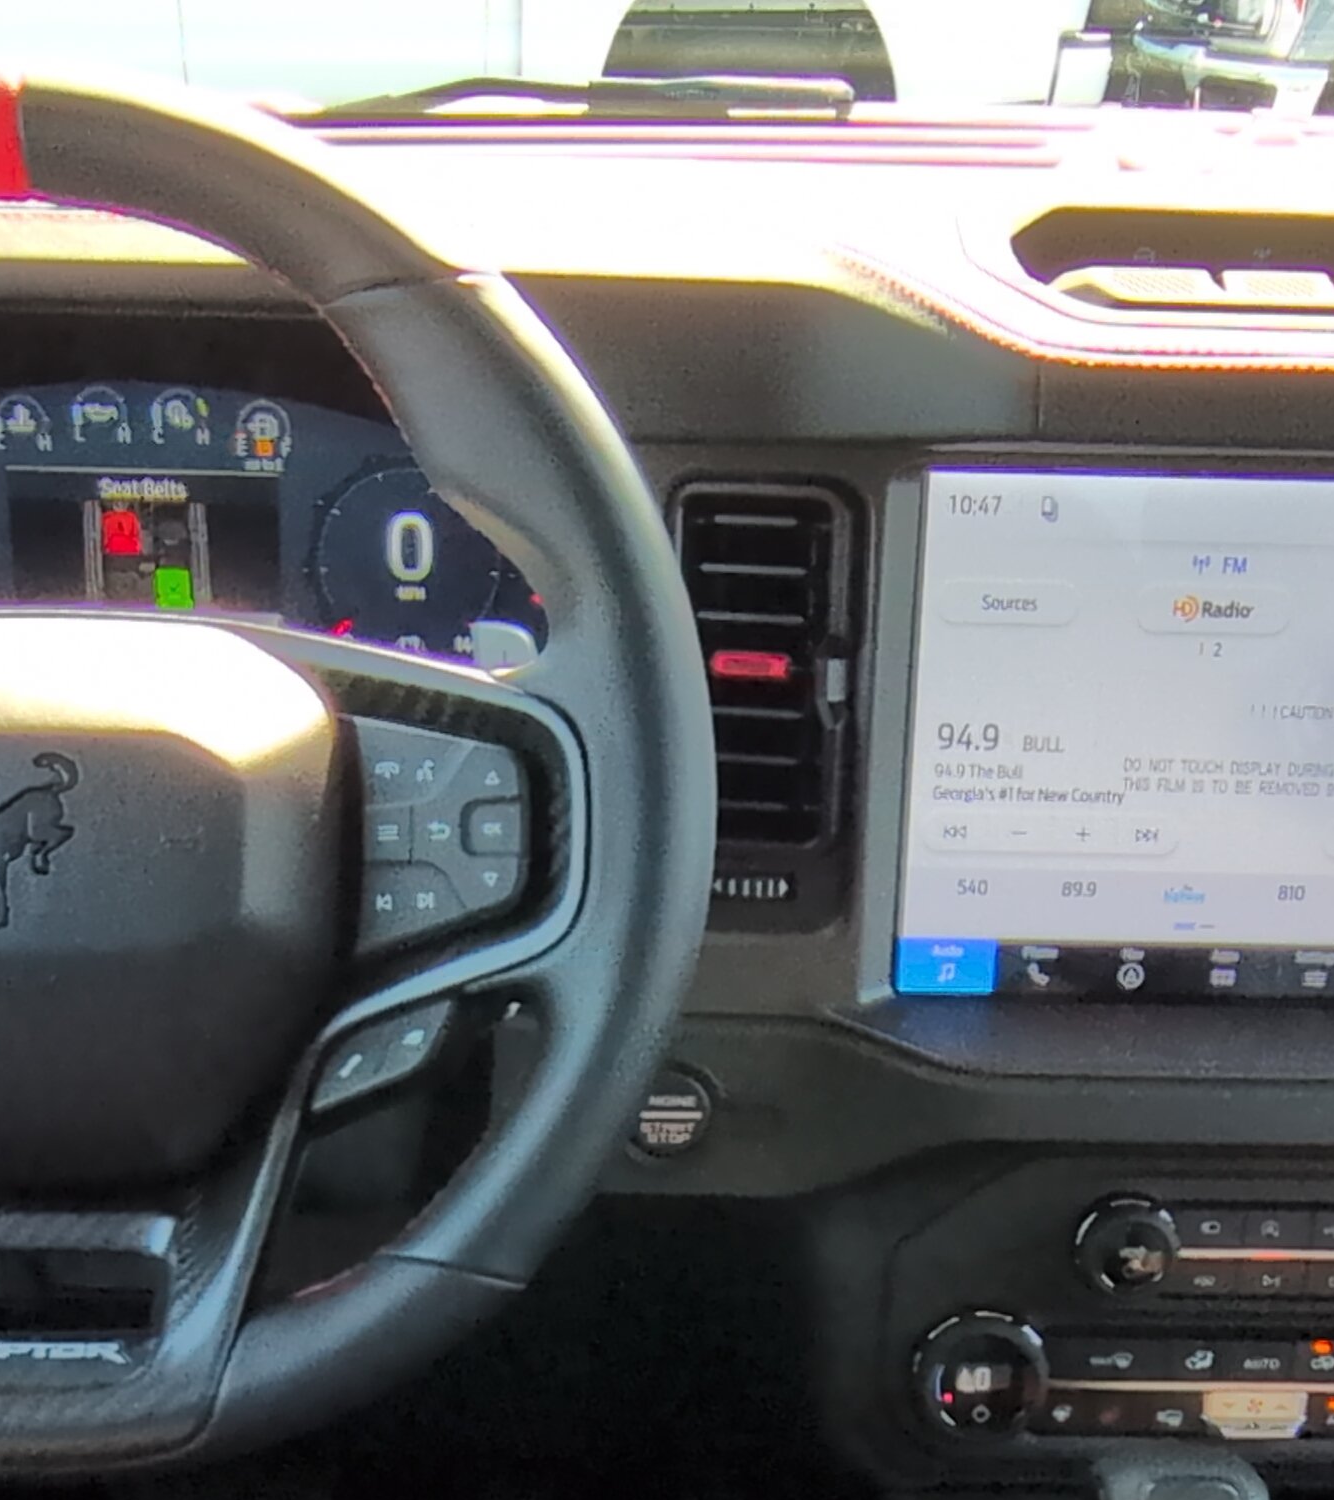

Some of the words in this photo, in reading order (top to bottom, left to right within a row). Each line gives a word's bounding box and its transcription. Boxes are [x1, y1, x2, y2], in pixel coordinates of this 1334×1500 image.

[97, 476, 139, 500] Seat
[142, 477, 189, 502] Belts
[948, 494, 1003, 517] 10:47
[386, 509, 435, 584] 0
[1221, 556, 1248, 575] FM
[981, 594, 1038, 613] Sources
[1201, 600, 1255, 620] Radio
[1213, 641, 1223, 658] 2
[1279, 705, 1334, 721] CAUTION
[937, 722, 1000, 751] 94.9
[1022, 735, 1066, 753] BULL
[969, 763, 994, 780] The
[997, 764, 1024, 780] Bull
[1123, 757, 1141, 773] DO
[1148, 758, 1174, 774] NOT
[1181, 759, 1223, 775] TOUCH
[1230, 761, 1280, 777] DISPLAY
[1287, 762, 1334, 778] DURING
[932, 785, 996, 803] Georgia's
[1017, 787, 1035, 801] for
[1038, 788, 1068, 802] New
[1071, 788, 1125, 806] Country
[1123, 776, 1151, 793] THIS
[1157, 777, 1186, 793] FILM
[1192, 779, 1204, 793] IS
[1212, 779, 1229, 794] TO
[1234, 780, 1252, 795] BE
[1258, 780, 1323, 797] REMOVED
[956, 878, 989, 896] 540
[1060, 880, 1098, 899] 89.9
[1277, 884, 1306, 901] 810
[1242, 1357, 1281, 1371] AUTO
